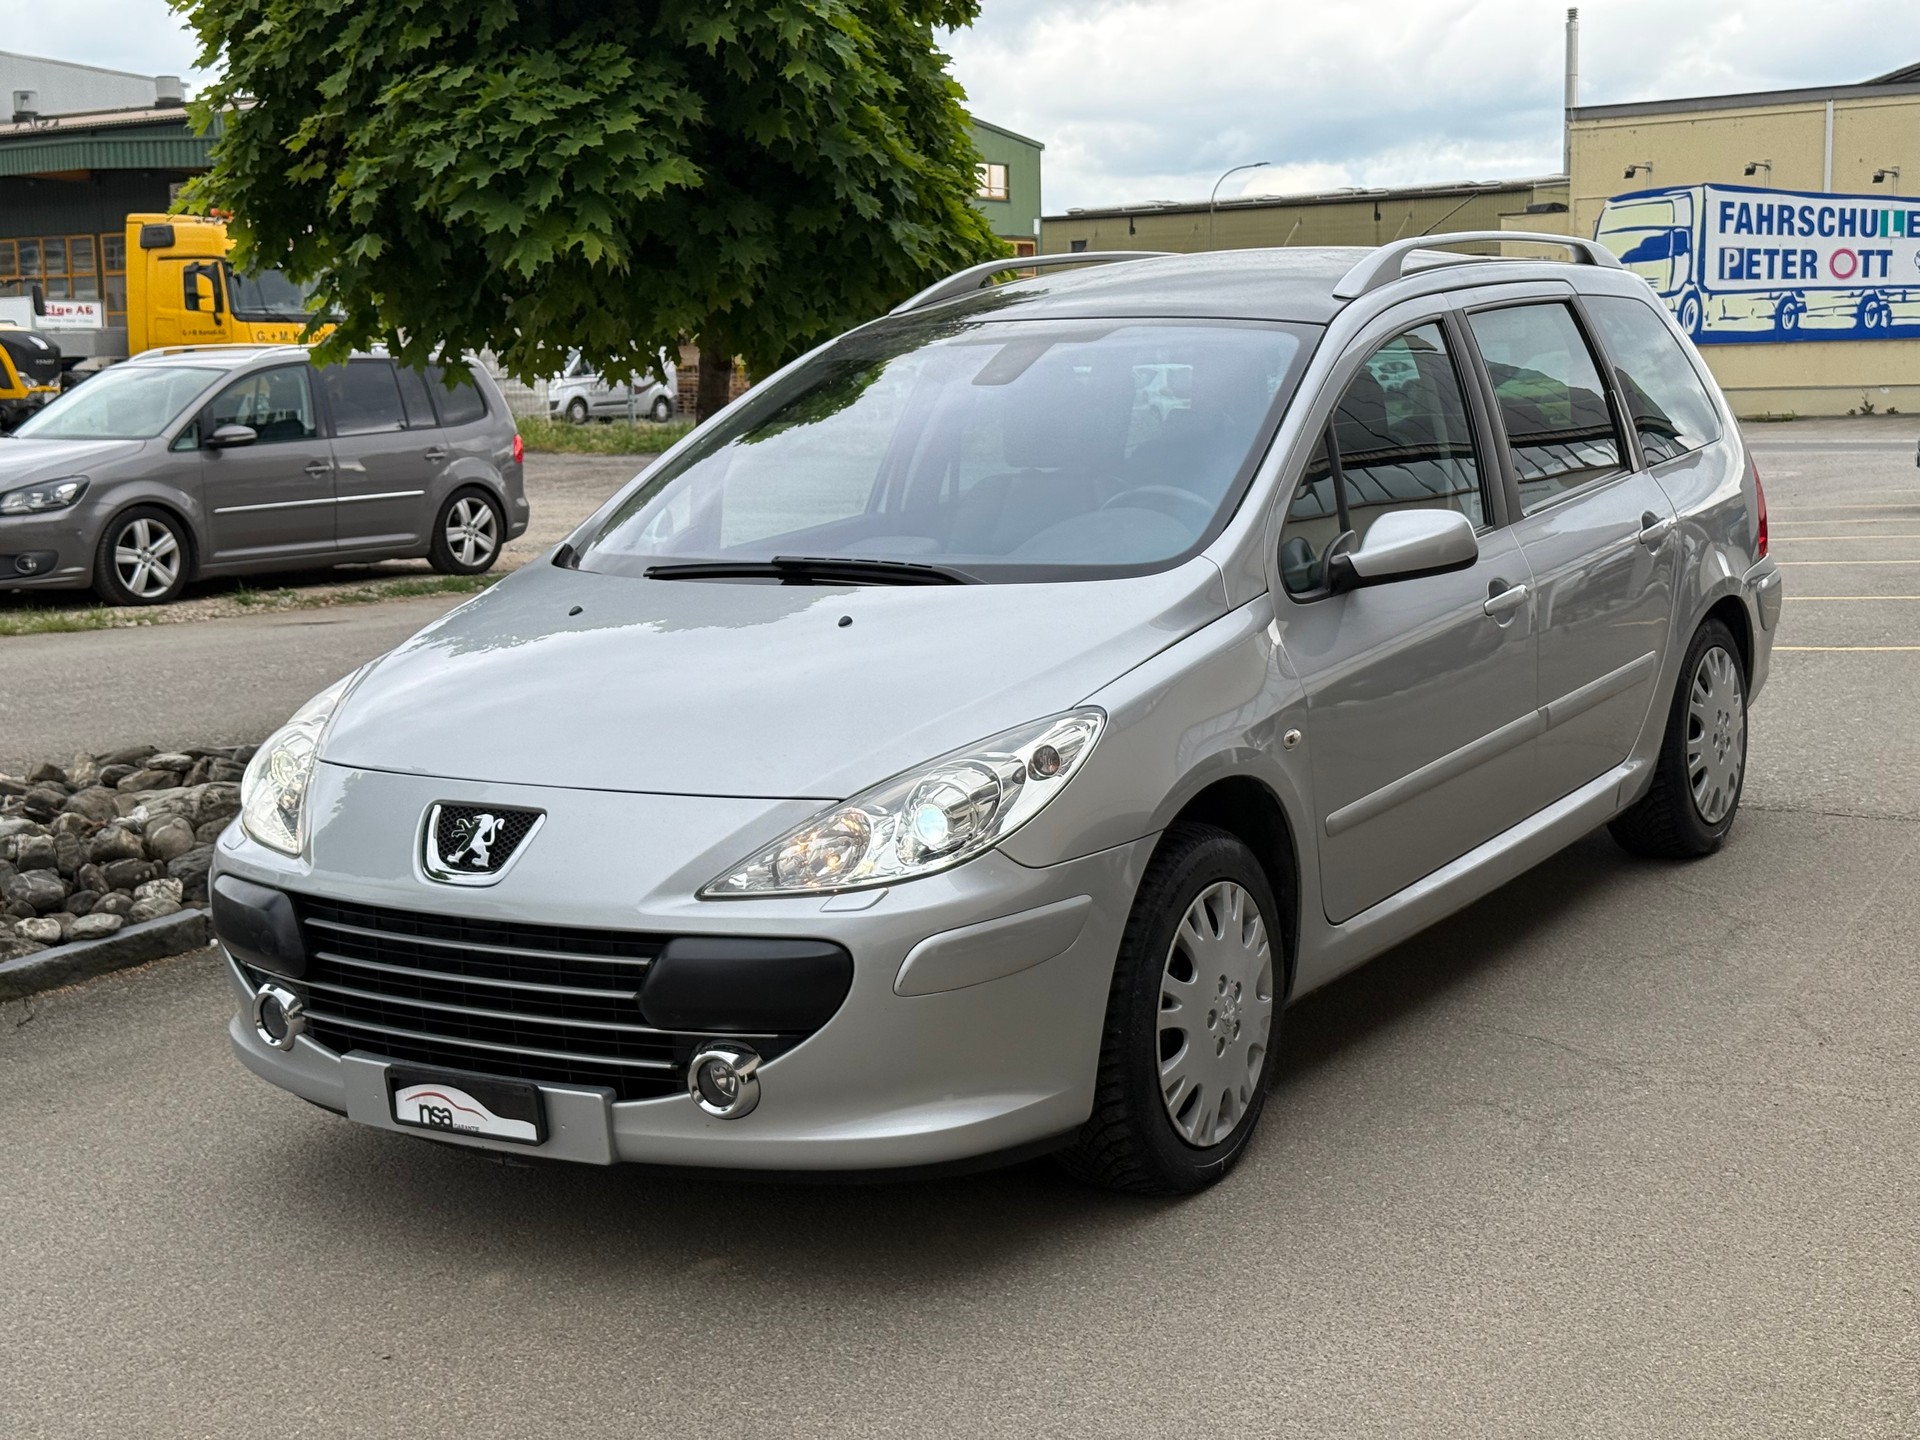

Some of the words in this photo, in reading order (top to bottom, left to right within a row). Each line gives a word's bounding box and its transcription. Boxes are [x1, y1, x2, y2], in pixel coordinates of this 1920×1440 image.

[1720, 201, 1920, 237] FAHRSCHULE
[1719, 248, 1817, 279] PETER
[1829, 248, 1893, 279] OTT
[419, 1104, 453, 1128] nsa
